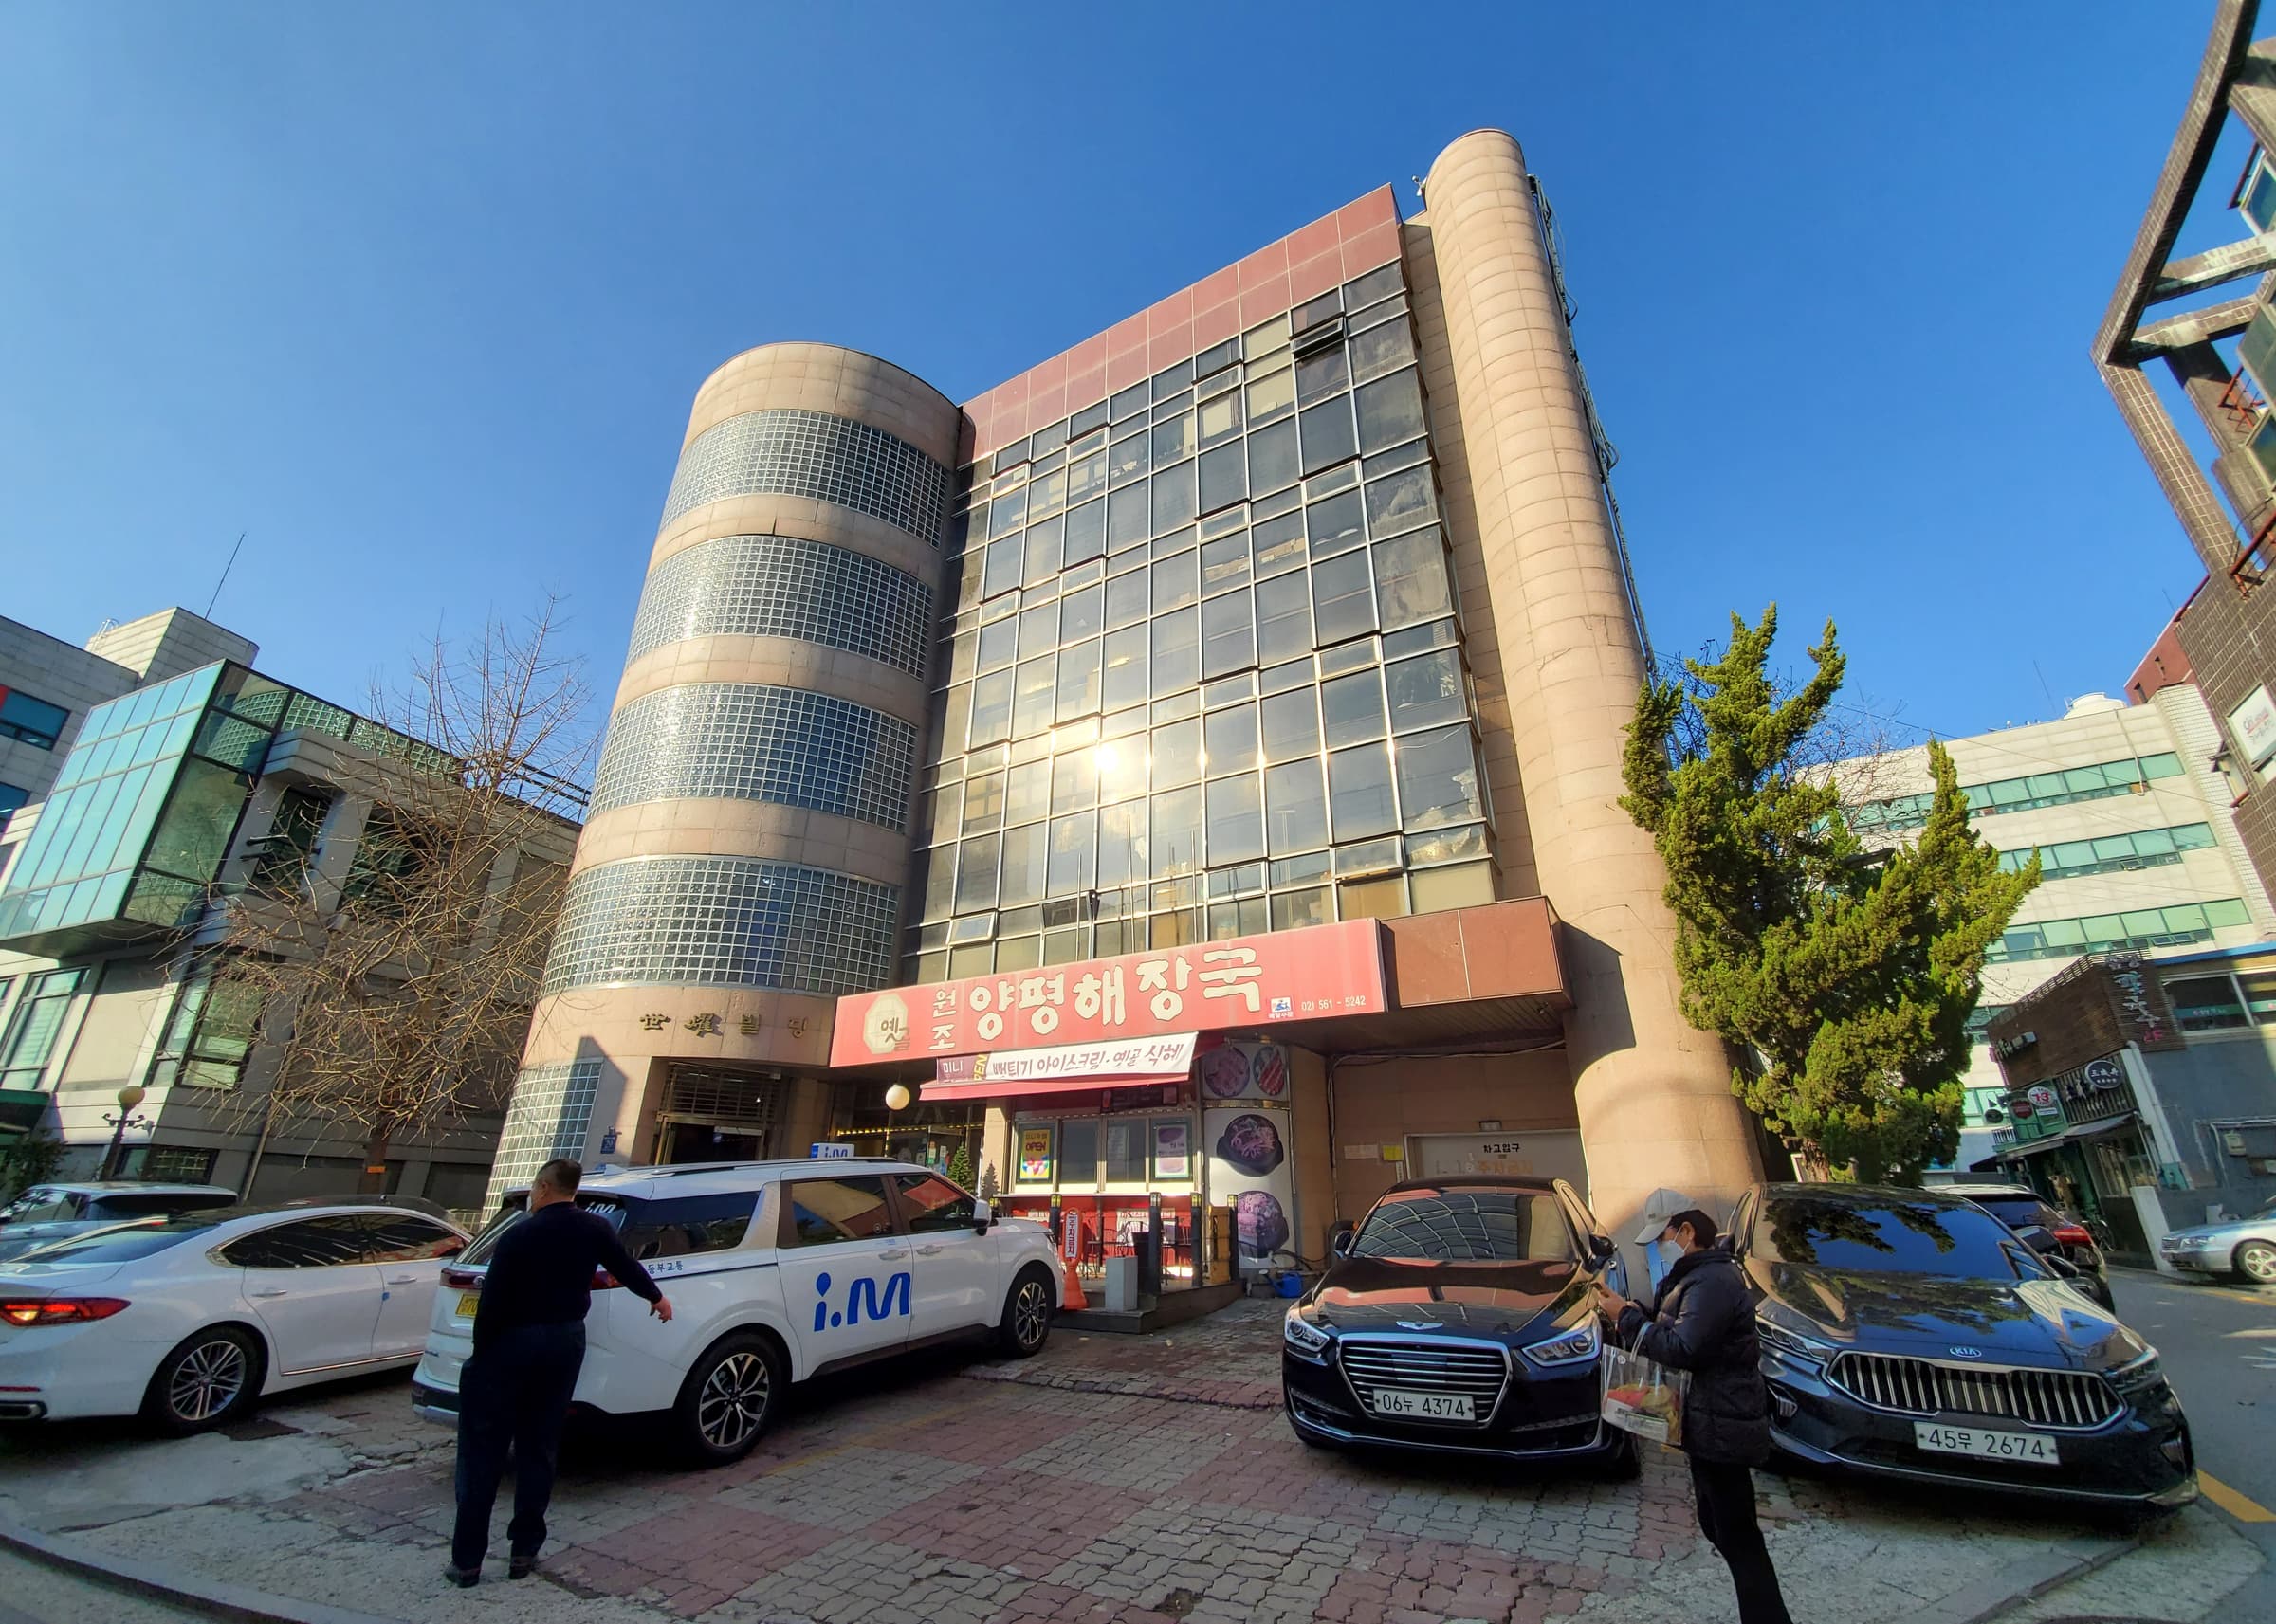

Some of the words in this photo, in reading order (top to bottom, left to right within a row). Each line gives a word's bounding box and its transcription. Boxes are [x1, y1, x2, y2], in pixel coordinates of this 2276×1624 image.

[969, 946, 1263, 1041] 양평해장국
[1318, 998, 1333, 1010] 561
[1345, 995, 1366, 1007] 5242
[928, 989, 957, 1050] 원조
[943, 1061, 963, 1073] 미니
[973, 1053, 988, 1081] PEN
[1037, 1050, 1106, 1074] 아이스크림
[1145, 1043, 1184, 1066] 식혜
[1025, 1140, 1047, 1152] OPEN
[1483, 1143, 1521, 1153] 차고입구
[648, 1260, 683, 1275] 동부교통
[1955, 1346, 1978, 1356] KIA
[1383, 1394, 1413, 1411] 06누
[1422, 1397, 1465, 1416] 4374
[1929, 1428, 1973, 1450] 45무
[1984, 1433, 2045, 1458] 2674
